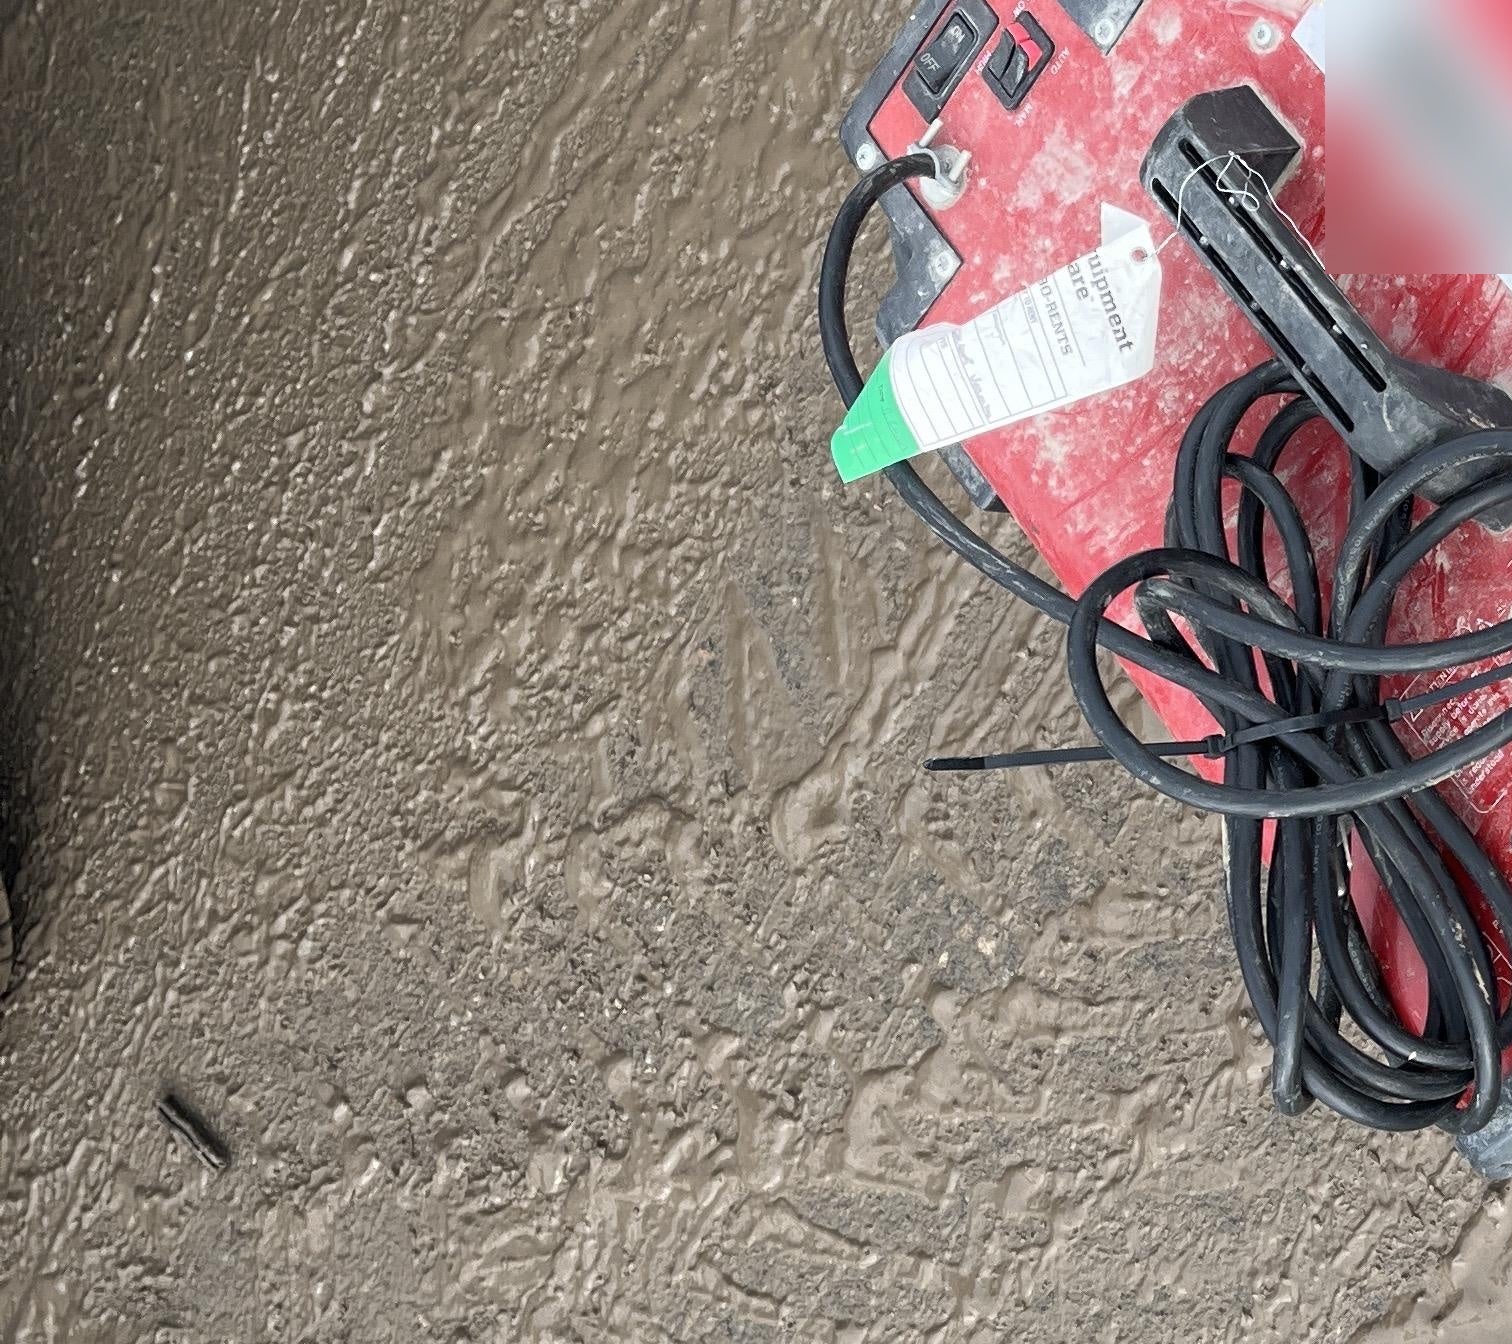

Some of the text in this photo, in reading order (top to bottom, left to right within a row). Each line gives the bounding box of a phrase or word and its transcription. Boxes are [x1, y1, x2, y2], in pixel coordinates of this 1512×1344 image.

[919, 52, 941, 74] OFF
[1051, 49, 1070, 75] AUTO
[1066, 262, 1088, 301] are
[1086, 254, 1135, 354] uipment
